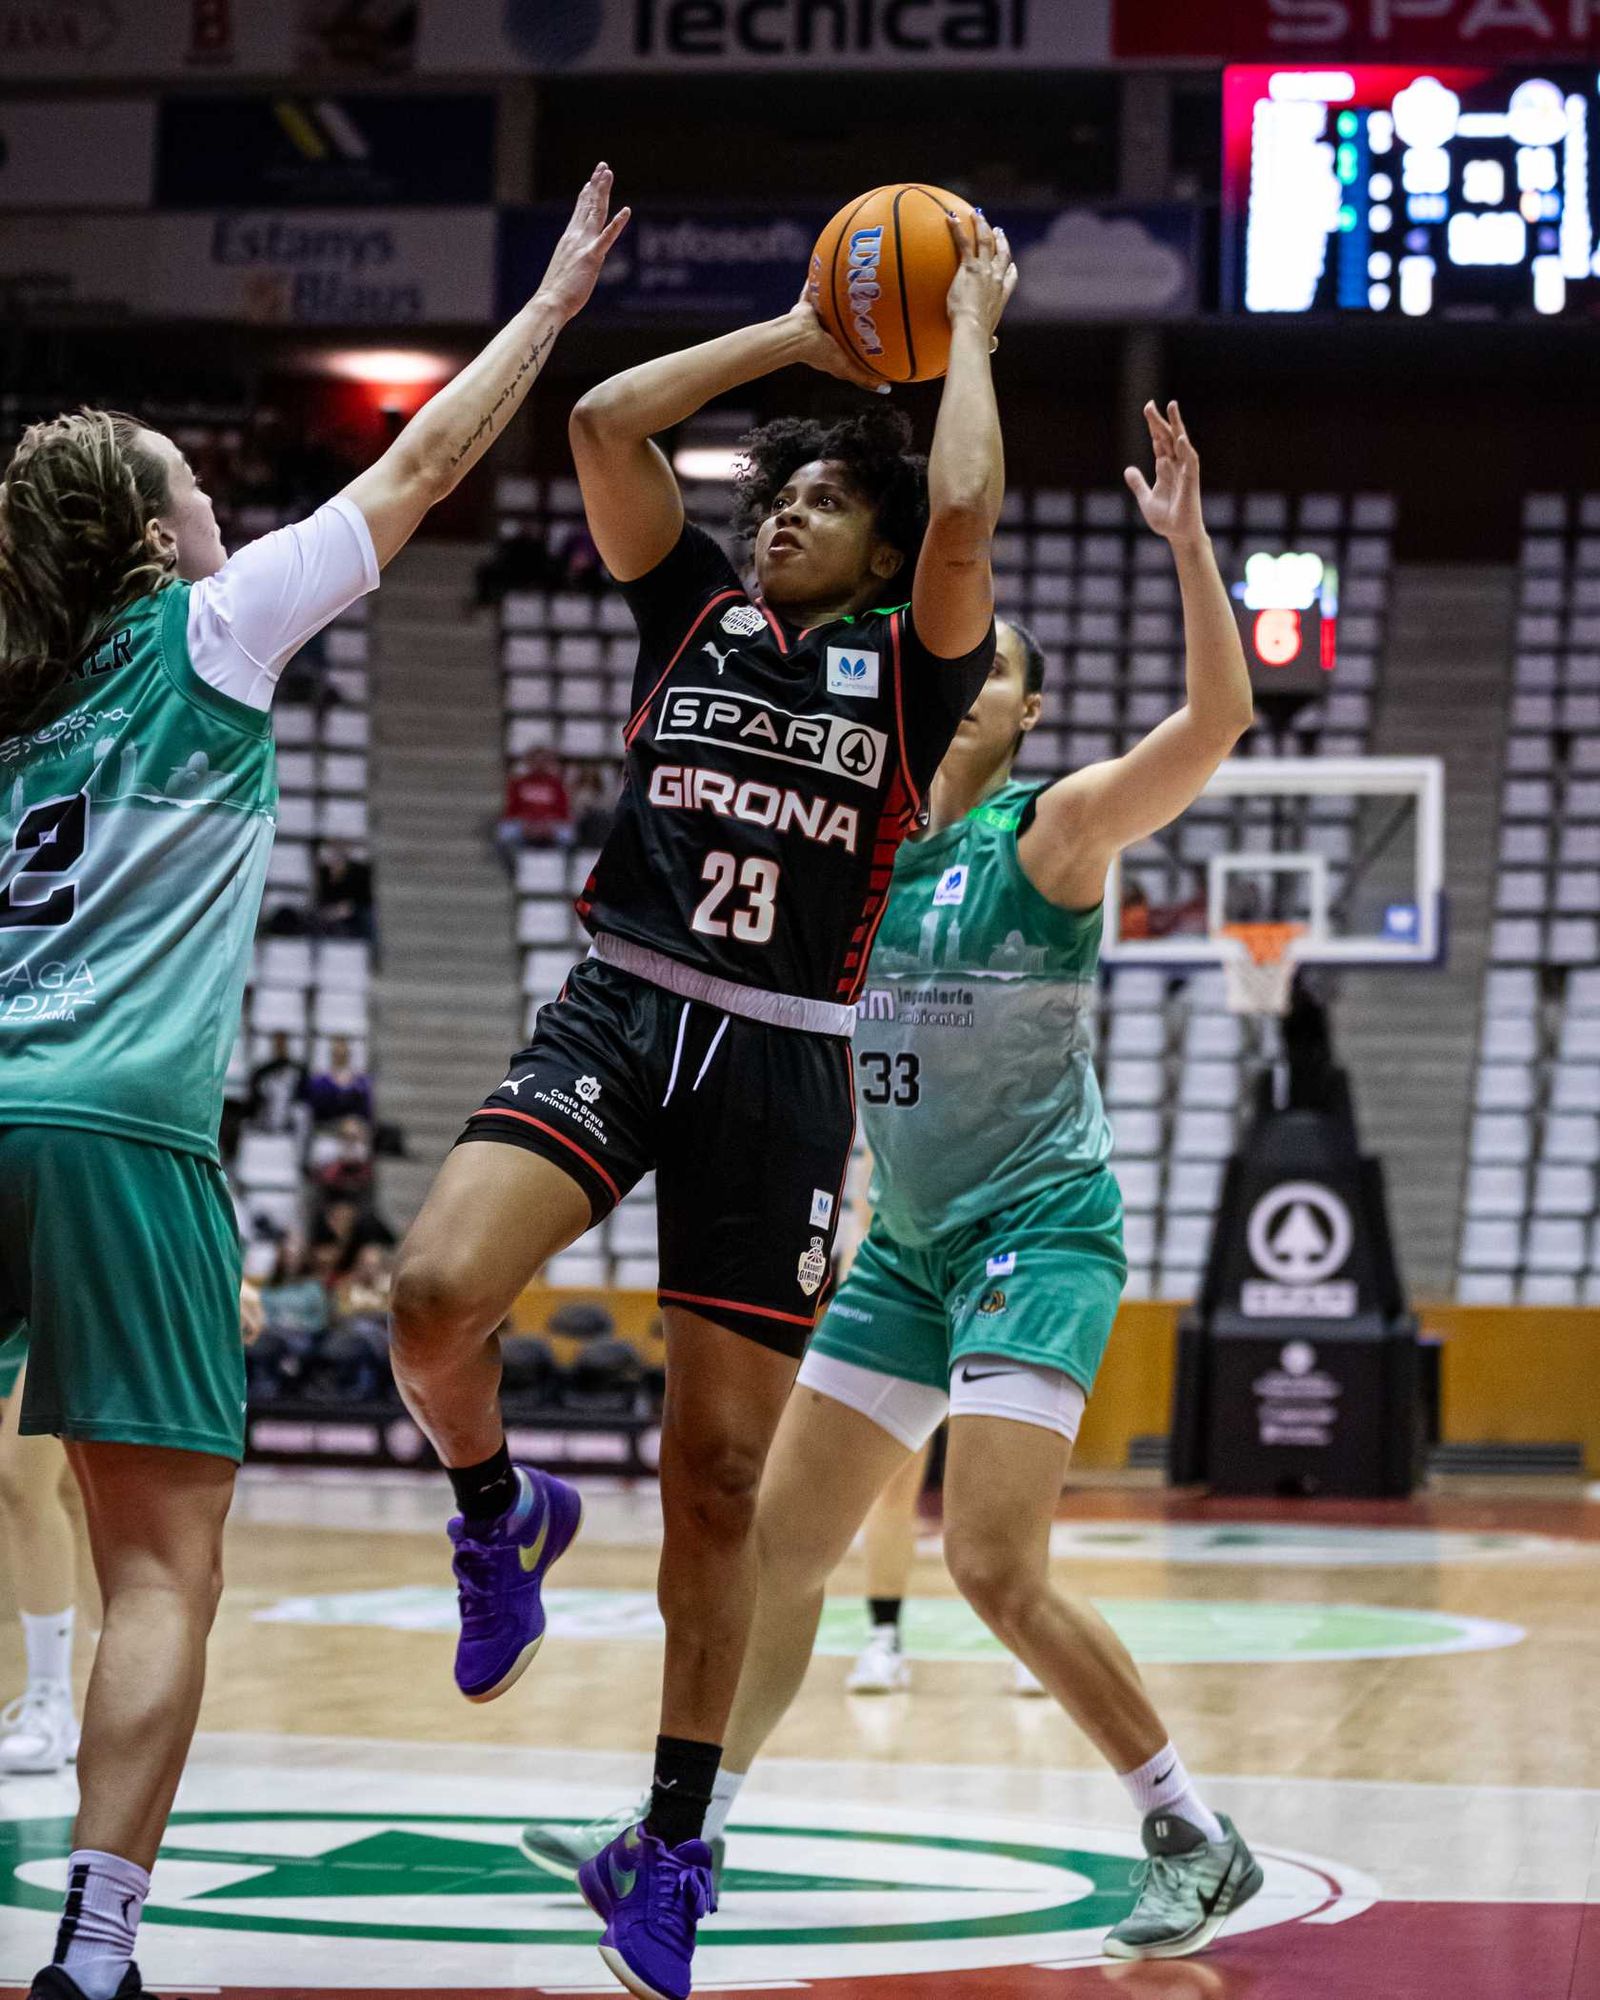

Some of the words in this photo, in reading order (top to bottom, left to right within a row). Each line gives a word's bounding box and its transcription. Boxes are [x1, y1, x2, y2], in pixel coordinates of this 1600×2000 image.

[848, 224, 885, 357] Wilson
[669, 698, 827, 755] SPAR
[648, 764, 862, 856] GIRONA
[689, 850, 781, 944] 23
[0, 959, 95, 989] AGA
[859, 1050, 921, 1108] 33
[534, 1091, 571, 1115] Pirineu
[571, 1112, 584, 1122] de
[583, 1120, 609, 1145] Girona
[550, 1088, 579, 1109] Costa
[580, 1105, 604, 1128] Brava
